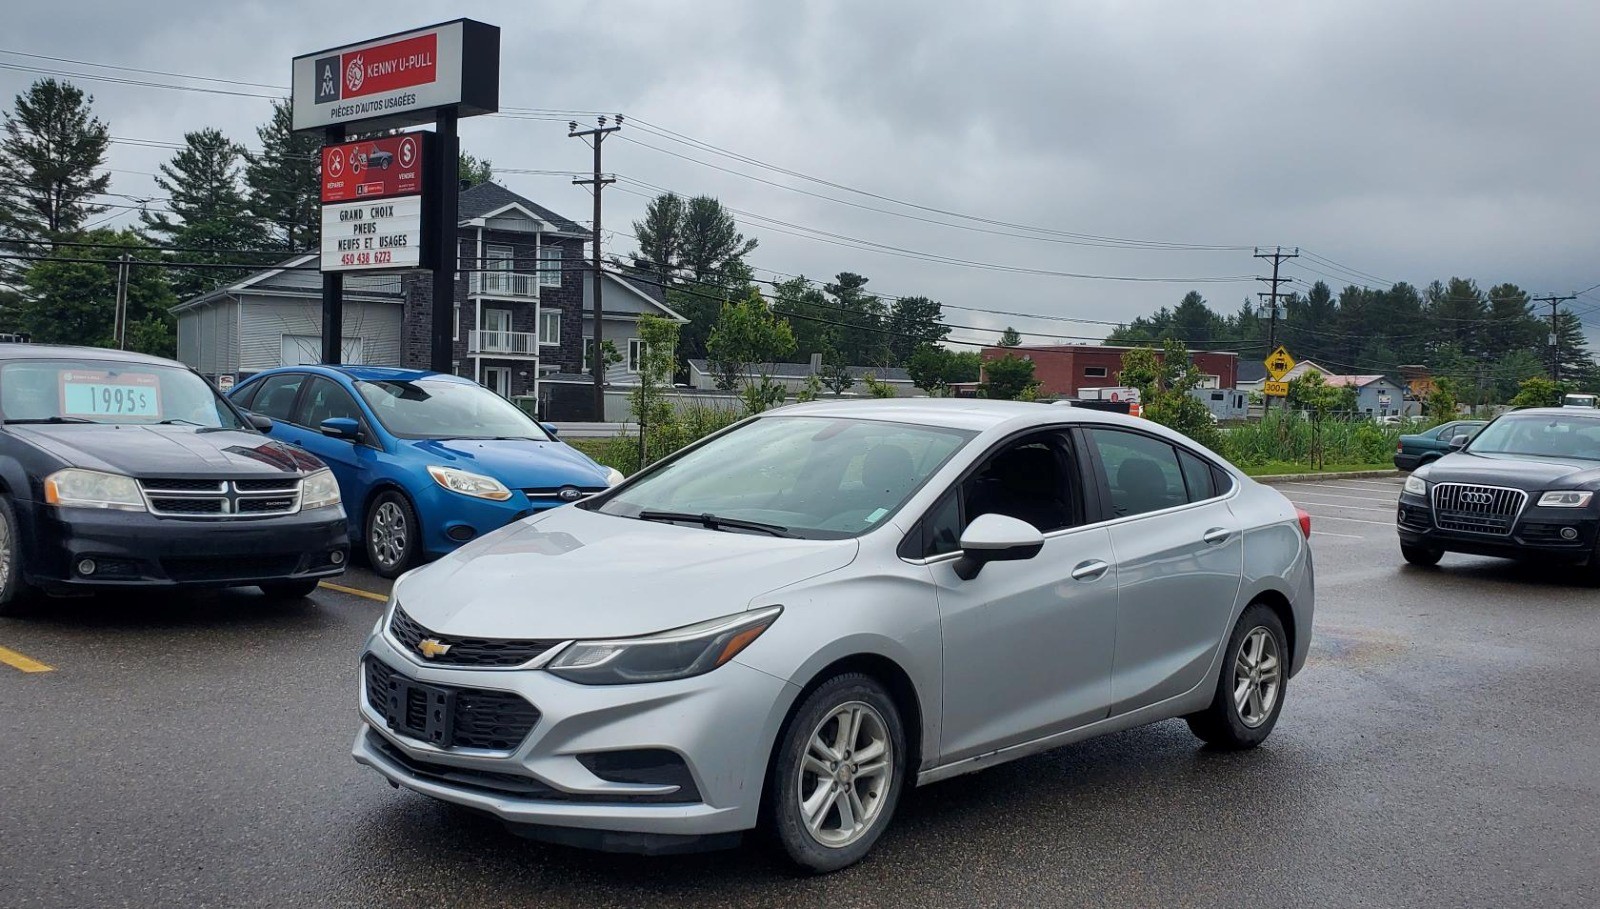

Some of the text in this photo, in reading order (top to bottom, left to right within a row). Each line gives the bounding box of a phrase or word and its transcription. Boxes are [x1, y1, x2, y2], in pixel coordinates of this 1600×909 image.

[367, 52, 432, 78] KENNY U-PULL
[331, 92, 416, 118] PIÈCES D'AUTOS USAGÉES
[340, 206, 393, 221] GRAND CHOIX
[353, 222, 377, 235] PNEUS
[338, 234, 407, 251] NEUFS ET USAGES
[341, 251, 391, 265] 450 438 6273
[1266, 384, 1280, 392] 300
